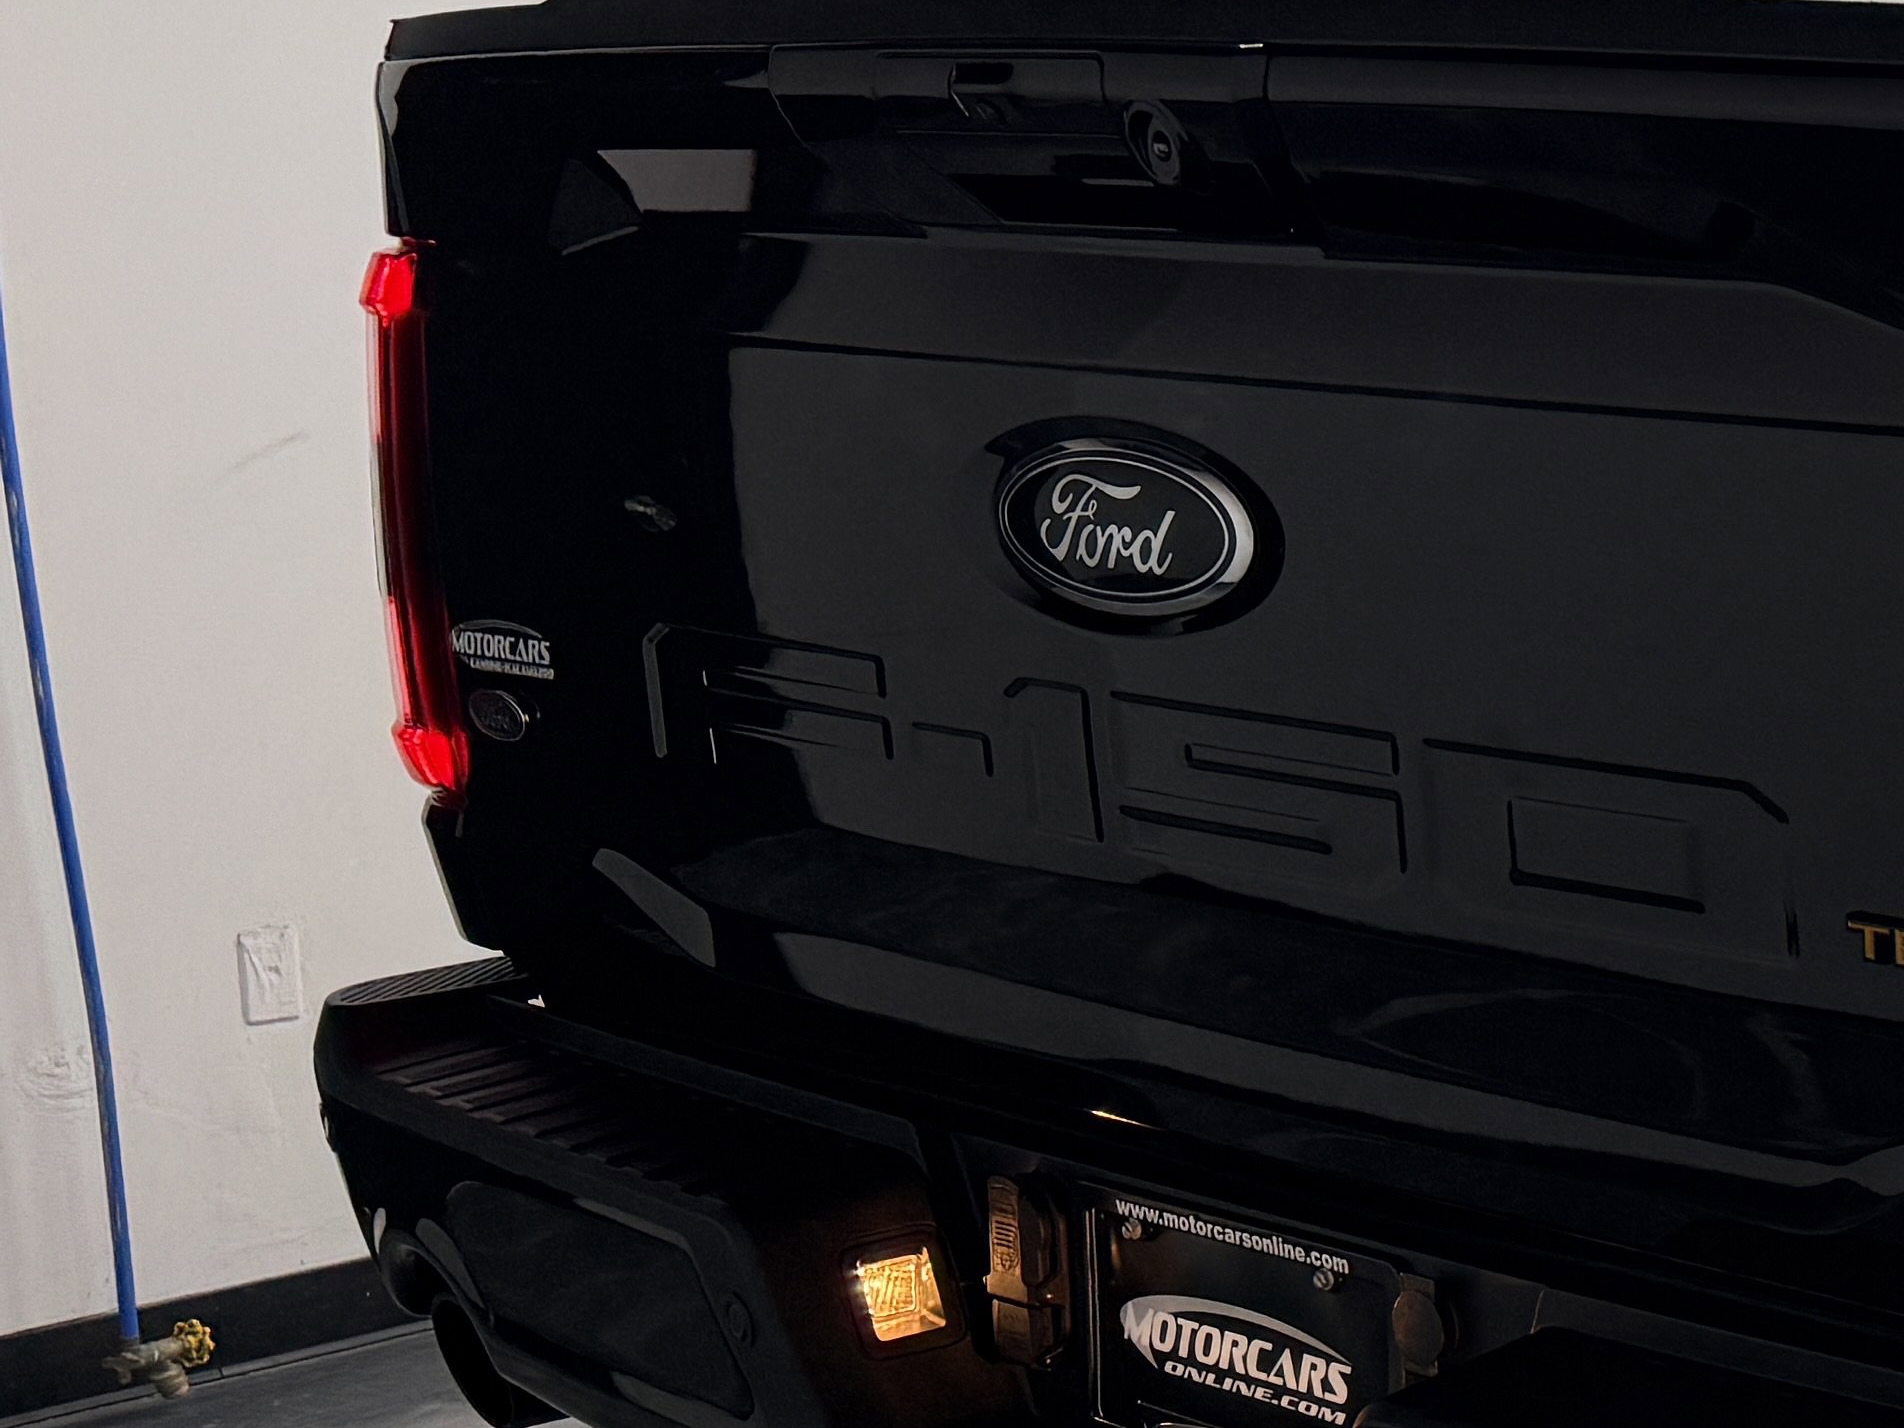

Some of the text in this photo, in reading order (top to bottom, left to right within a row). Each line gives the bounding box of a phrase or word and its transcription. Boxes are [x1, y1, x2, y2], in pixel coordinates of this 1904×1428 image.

[1039, 472, 1176, 576] Ford
[451, 629, 551, 665] MOTORCARS
[1115, 1198, 1350, 1275] www.motorcarsonline.com
[1123, 1307, 1353, 1405] MOTORCARS
[1163, 1360, 1347, 1426] ONLINE.COM
